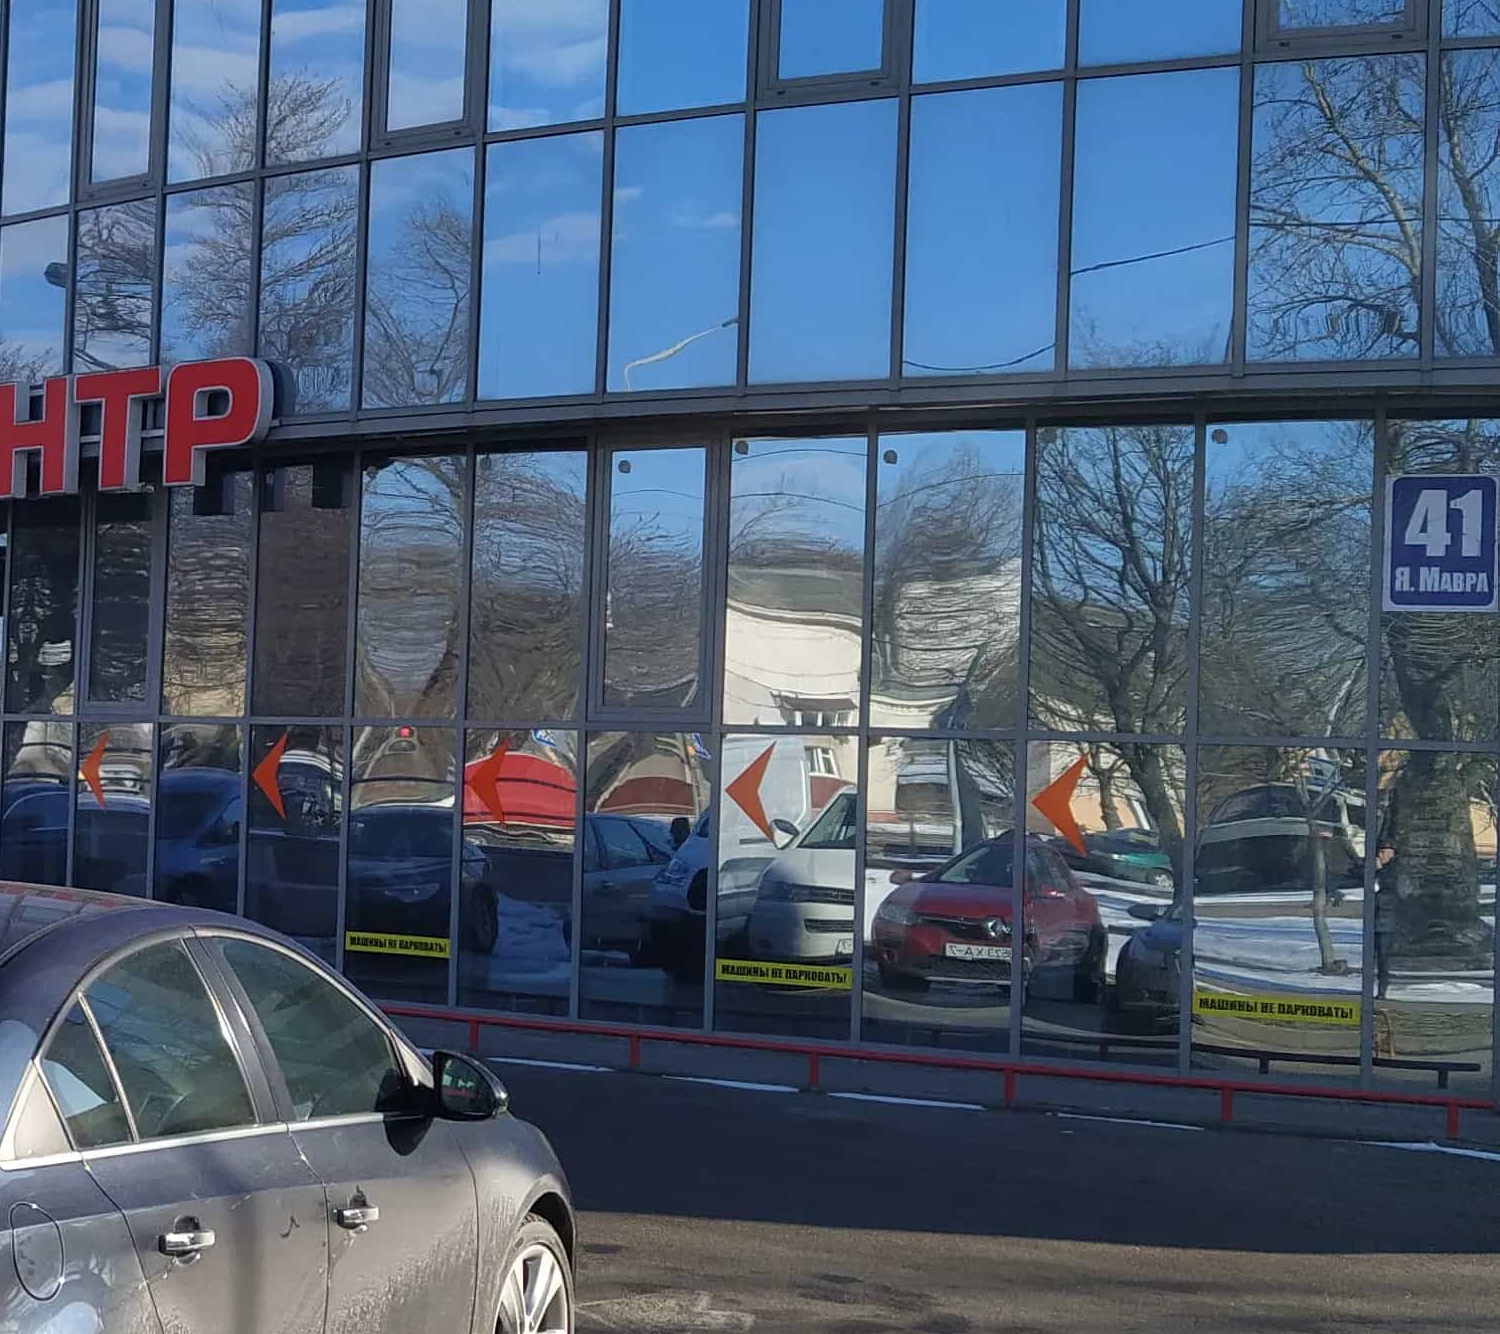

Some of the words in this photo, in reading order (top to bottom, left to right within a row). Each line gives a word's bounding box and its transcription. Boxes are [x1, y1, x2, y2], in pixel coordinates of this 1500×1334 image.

[1404, 489, 1483, 557] 41
[1395, 566, 1415, 592] Я.
[721, 964, 769, 977] МАШИНЫ
[771, 968, 783, 979] НЕ
[1199, 998, 1258, 1012] МАШИНЫ
[1260, 1002, 1275, 1014] НЕ
